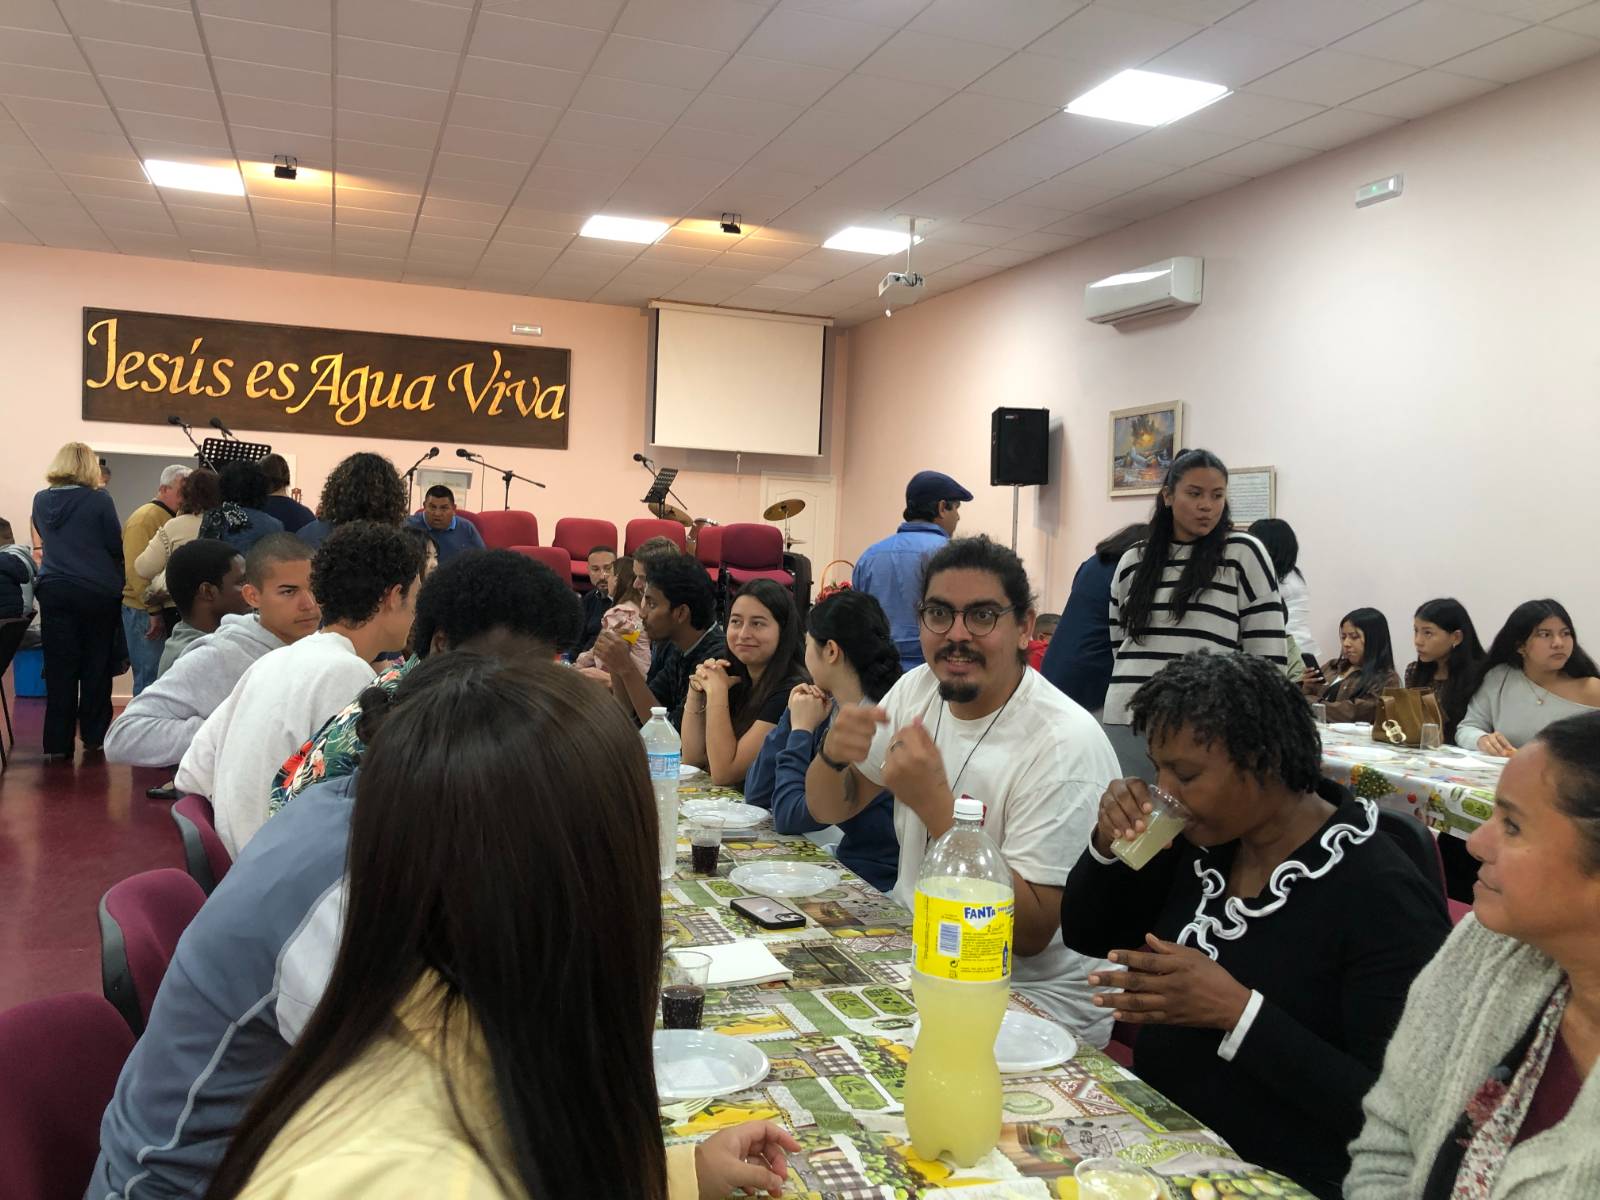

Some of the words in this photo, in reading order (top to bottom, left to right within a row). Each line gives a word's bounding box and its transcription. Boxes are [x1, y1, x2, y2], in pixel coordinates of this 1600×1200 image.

[86, 318, 234, 398] Jesús
[245, 360, 299, 400] es
[285, 352, 436, 426] Agua
[447, 349, 566, 420] Viva
